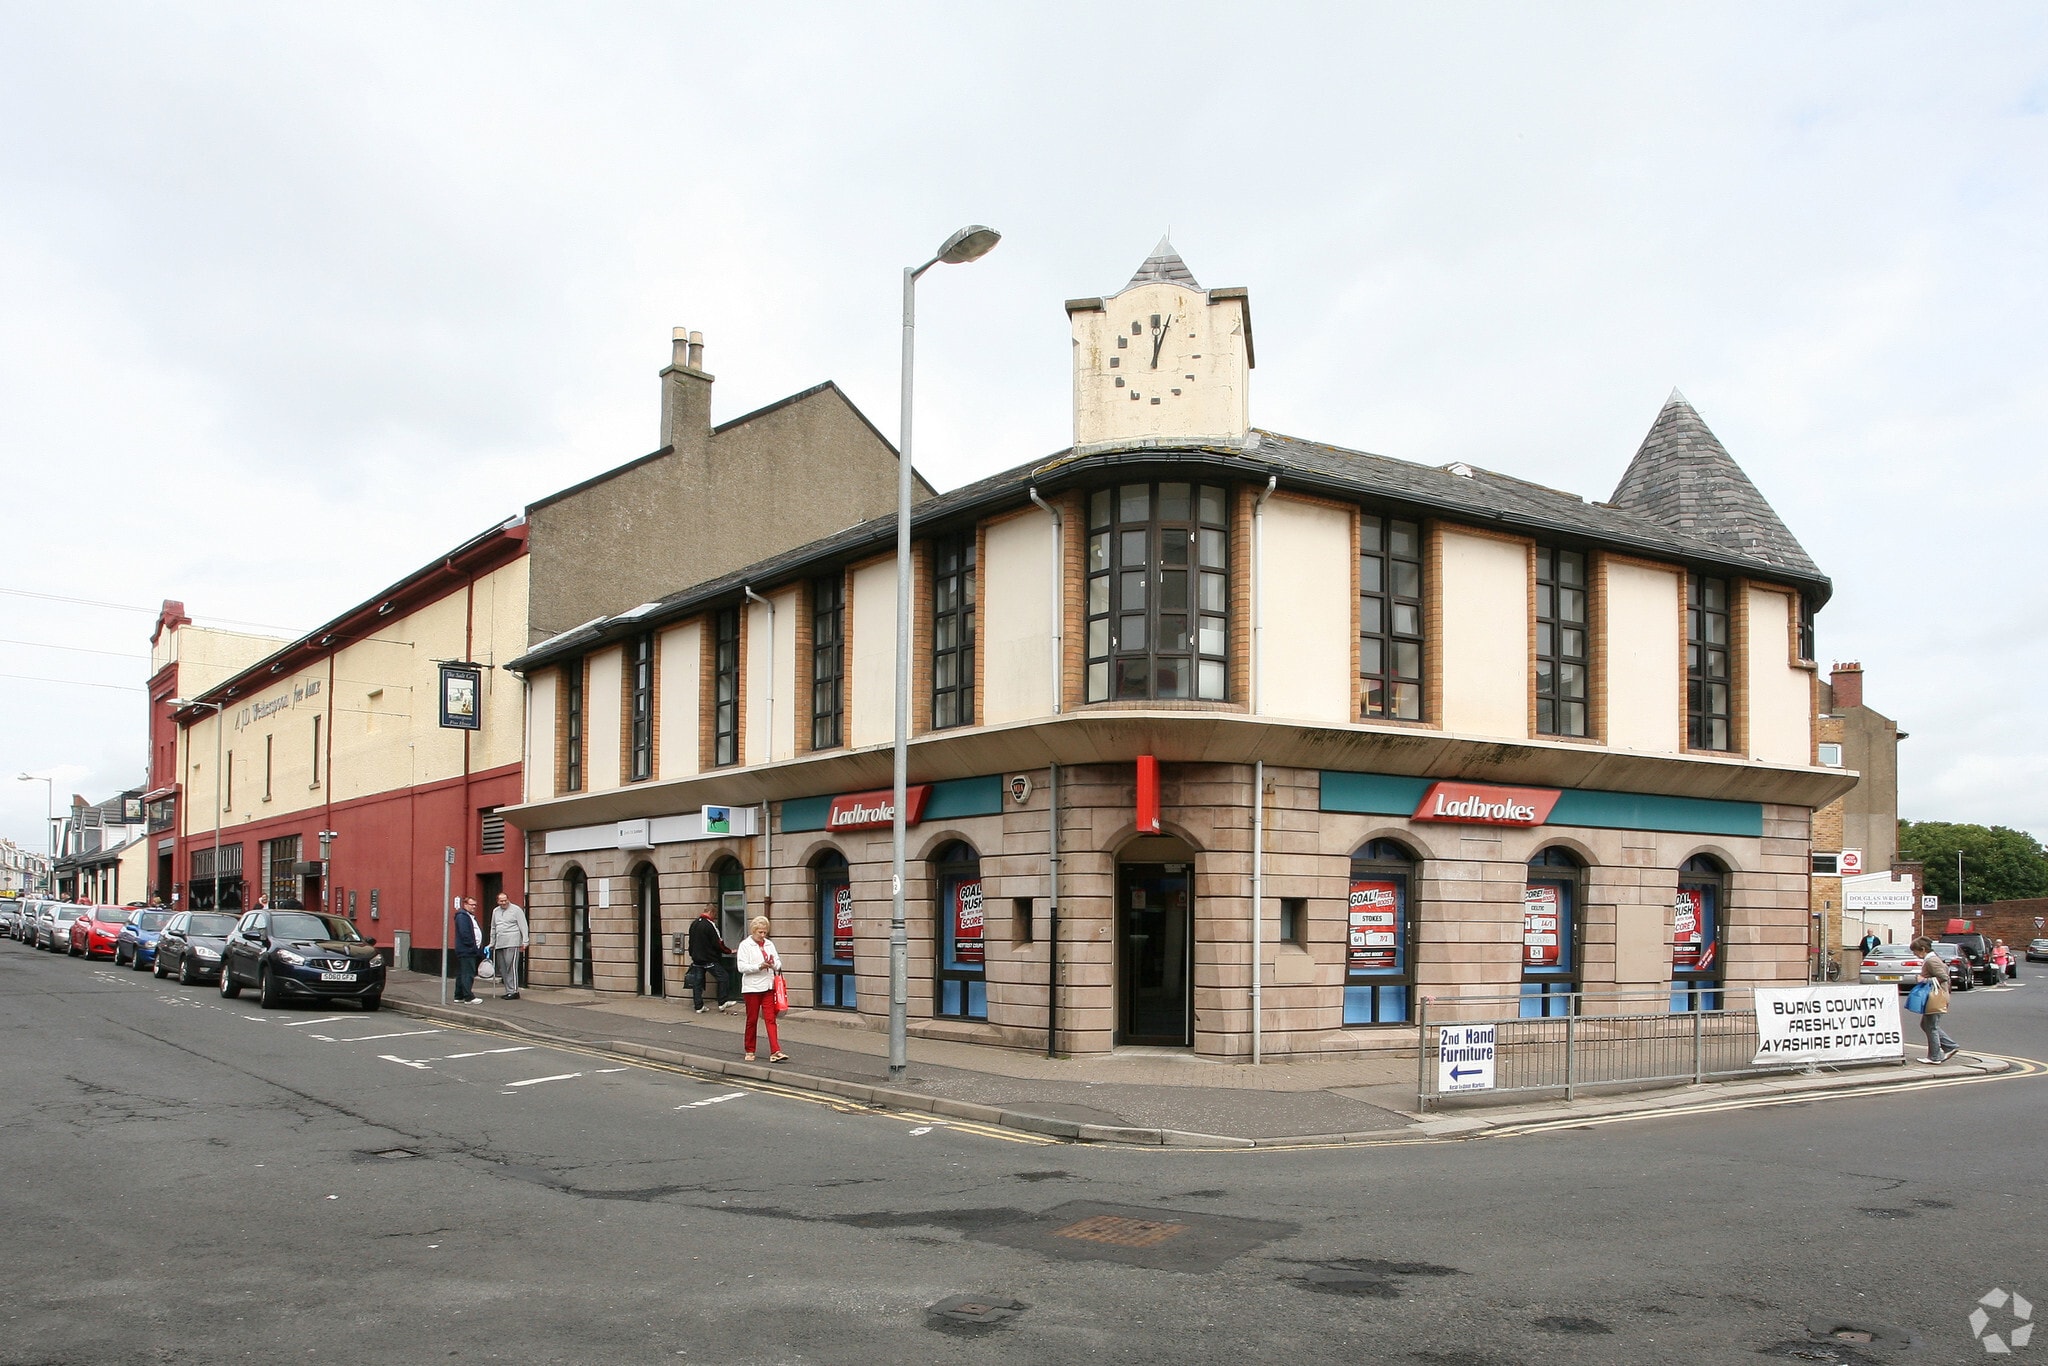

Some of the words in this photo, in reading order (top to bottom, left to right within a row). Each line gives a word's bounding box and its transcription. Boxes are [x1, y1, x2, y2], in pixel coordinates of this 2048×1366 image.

[832, 801, 895, 826] Ladbroke
[1434, 793, 1535, 820] Ladbrokes
[961, 884, 981, 899] GOAL
[1351, 891, 1377, 905] GOAL!
[1526, 889, 1543, 899] CORE!
[1675, 893, 1691, 905] OAL
[1675, 920, 1695, 932] CORE?
[1773, 1000, 1822, 1015] BURNS
[1826, 997, 1884, 1012] COUNTRY
[1789, 1017, 1846, 1033] FRESHLY
[1850, 1015, 1876, 1028] DUG
[1441, 1029, 1459, 1045] 2nd
[1466, 1028, 1493, 1044] Hand
[1760, 1036, 1831, 1053] AYRSHIRE
[1835, 1031, 1900, 1048] POTATOES
[1441, 1046, 1493, 1063] Furniture
